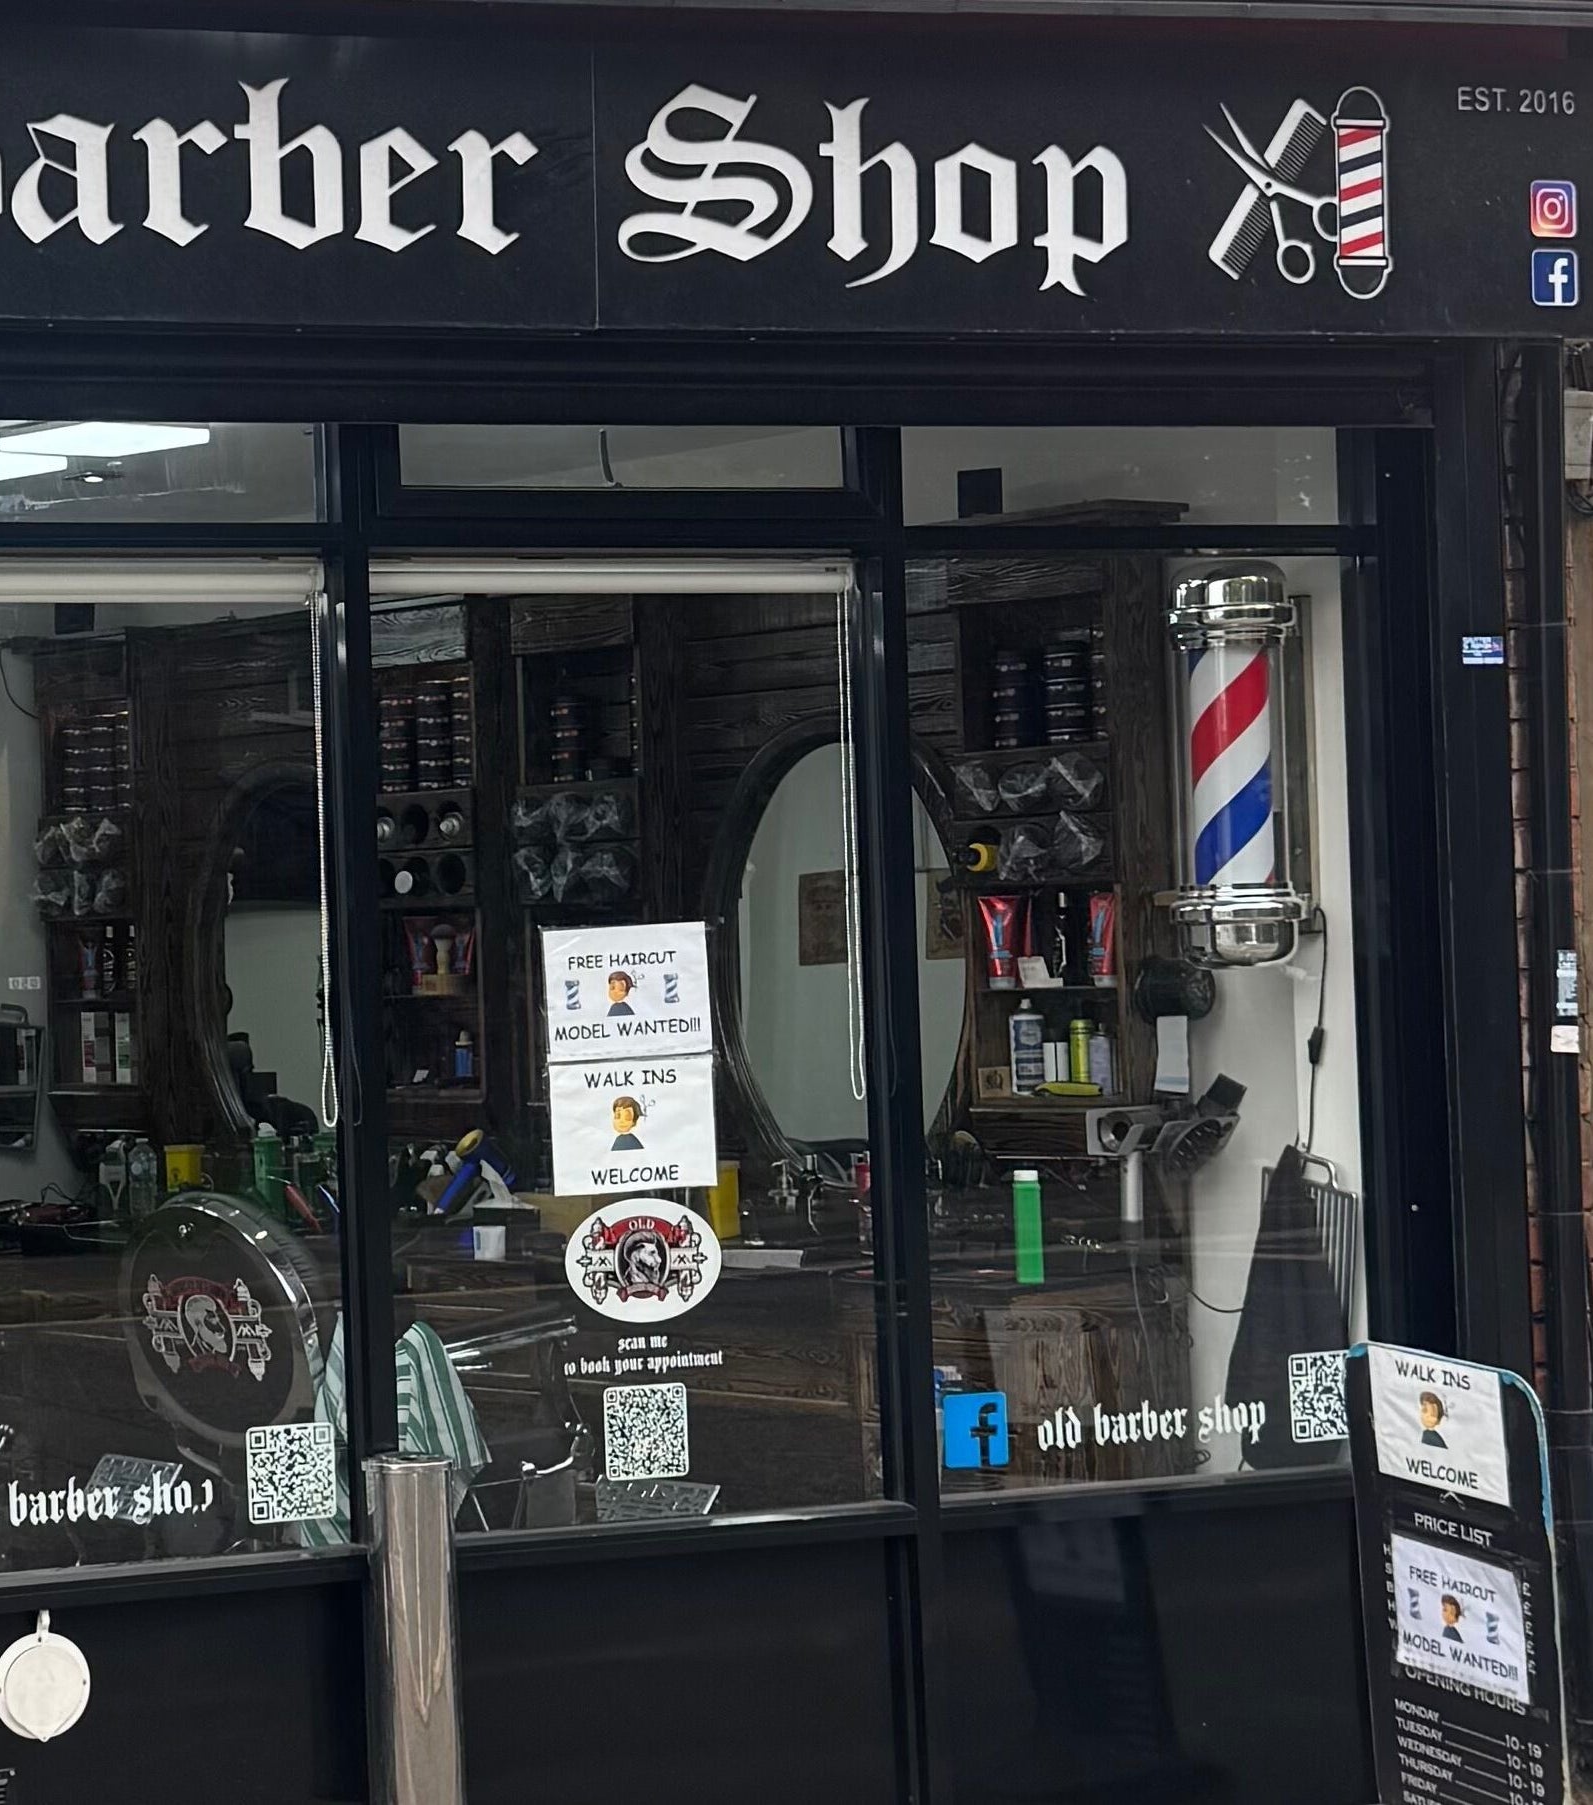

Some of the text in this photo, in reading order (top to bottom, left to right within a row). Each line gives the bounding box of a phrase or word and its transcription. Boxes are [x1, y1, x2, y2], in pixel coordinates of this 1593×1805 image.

[1457, 86, 1575, 114] EST. 2016
[617, 83, 1129, 297] Shop
[568, 951, 677, 970] FREE HAIRCUT
[555, 1016, 701, 1042] MODEL WANTED!!!
[584, 1069, 677, 1088] WALK INS
[591, 1165, 679, 1185] WELCOME
[628, 1218, 656, 1231] OLD
[618, 1335, 668, 1353] scan me
[580, 1356, 611, 1375] book
[614, 1357, 643, 1376] your
[647, 1350, 723, 1374] appointment
[1395, 1359, 1471, 1391] WALK INS
[1037, 1394, 1266, 1452] old barber shop
[1406, 1458, 1479, 1489] WELCOME
[8, 1476, 121, 1527] barber
[1414, 1512, 1493, 1547] PRICE LIST
[1409, 1565, 1438, 1587] FREE
[1442, 1575, 1497, 1603] HAIRCUT
[1402, 1630, 1519, 1681] MODEL WANTED!!!
[1394, 1698, 1440, 1722] MONDAY
[1395, 1716, 1443, 1742] TUESDAY
[1397, 1735, 1462, 1767] WEDNESDAY
[1398, 1752, 1453, 1782] THURSDAY
[1401, 1771, 1438, 1793] FRIDAY
